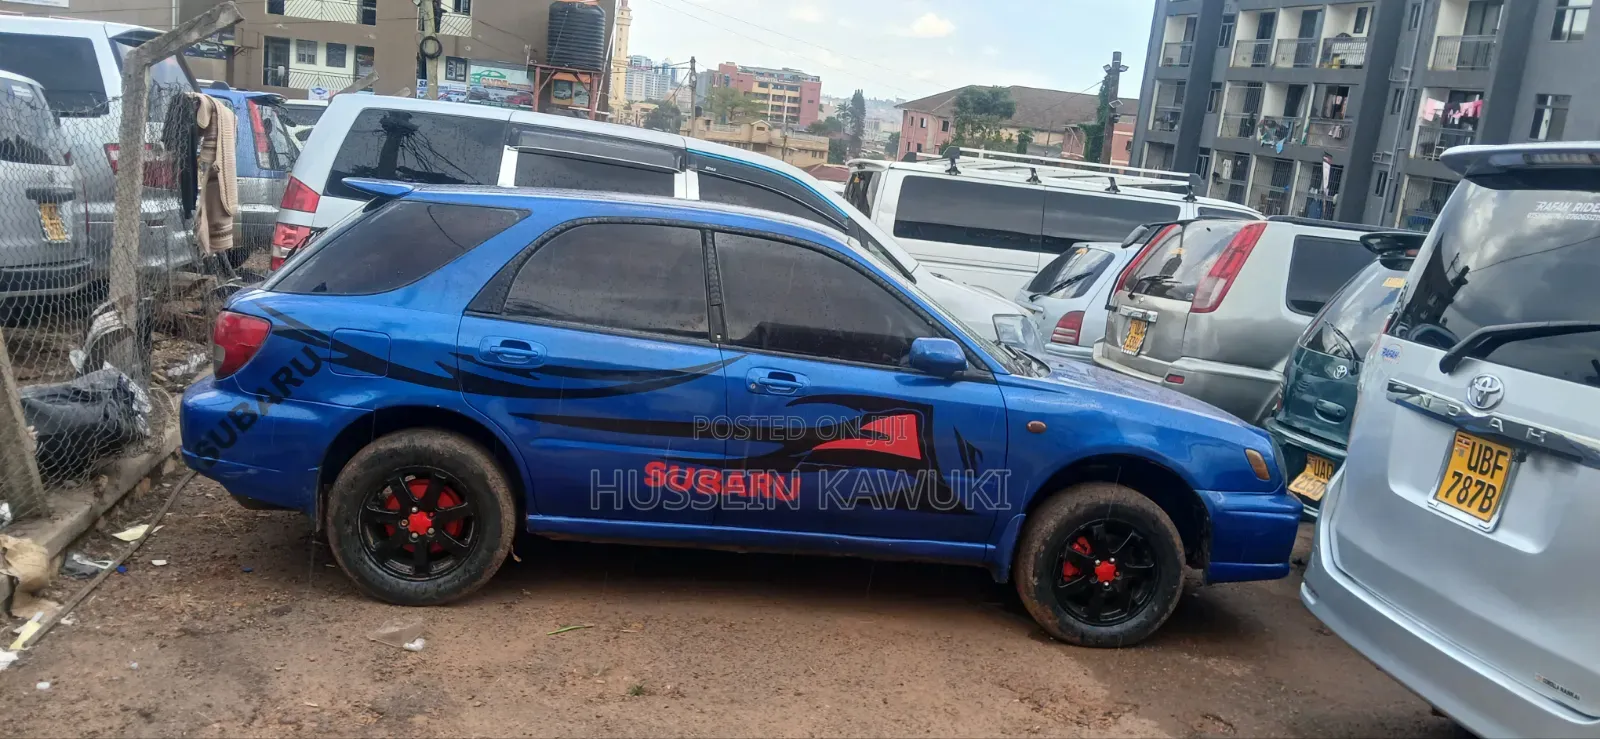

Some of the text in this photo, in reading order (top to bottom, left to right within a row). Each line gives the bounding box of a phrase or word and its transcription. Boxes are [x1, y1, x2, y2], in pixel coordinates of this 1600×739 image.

[1535, 201, 1572, 211] RAFAH
[194, 345, 323, 467] SUBARU
[1419, 393, 1546, 443] NOAH
[1466, 441, 1508, 479] UBF
[643, 461, 801, 502] SUBARU
[1445, 470, 1497, 513] 787B
